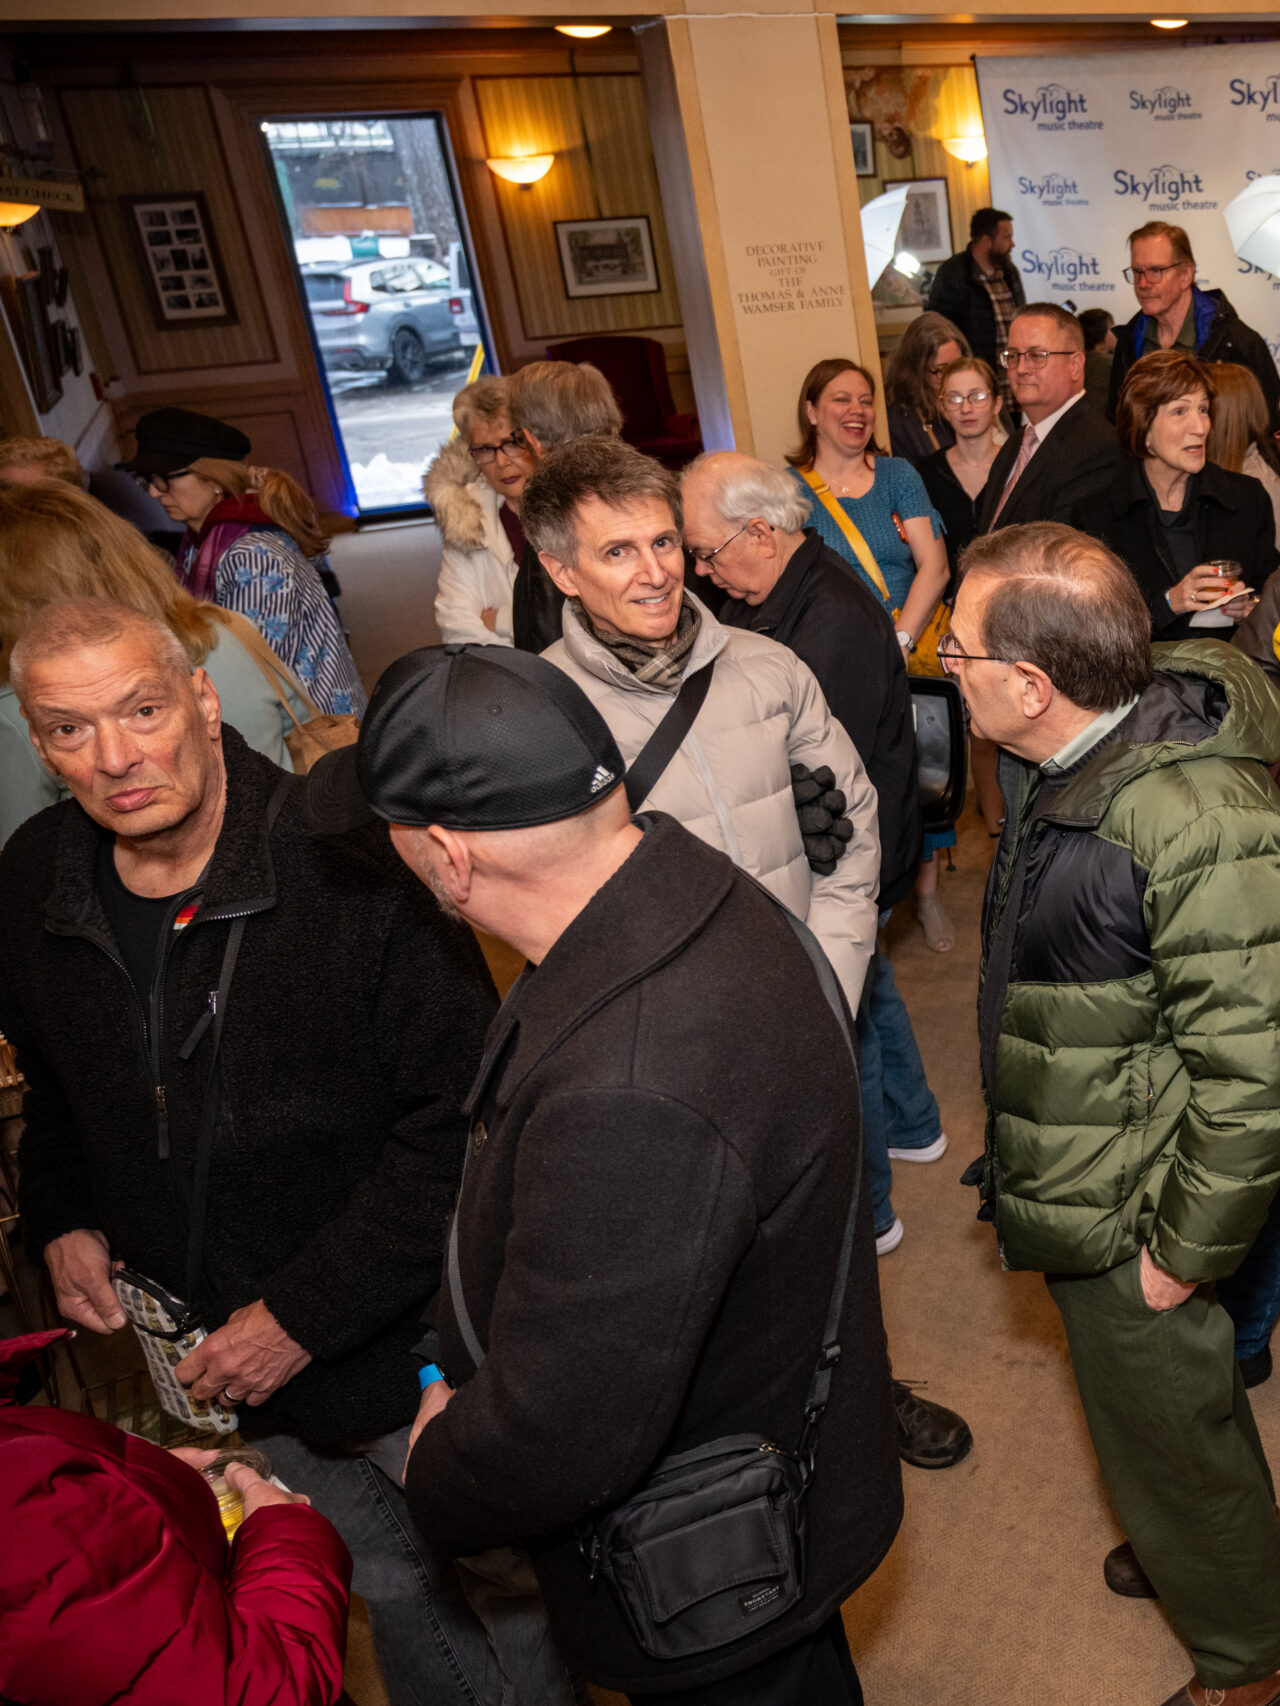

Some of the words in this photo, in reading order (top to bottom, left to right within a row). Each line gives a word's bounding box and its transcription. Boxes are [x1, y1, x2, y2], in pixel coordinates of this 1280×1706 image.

[1003, 88, 1088, 121] Skylight
[1129, 90, 1192, 115] Skylight
[1037, 120, 1066, 131] music
[1068, 118, 1104, 131] theatre
[1154, 113, 1176, 122] music
[1177, 112, 1202, 121] theatre
[1018, 176, 1079, 200] Skylight
[1113, 169, 1204, 202] Skylight
[1149, 202, 1180, 213] music
[1182, 200, 1218, 212] theatre
[746, 241, 824, 257] DECORATIVE
[757, 254, 818, 268] PAINTING
[1021, 249, 1100, 281] Skylight
[769, 267, 791, 277] GIFT
[778, 276, 803, 288] THE
[1052, 282, 1077, 292] music
[1079, 281, 1115, 292] theatre
[737, 290, 792, 304] THOMAS
[796, 289, 805, 299] &
[810, 285, 846, 297] ANNE
[743, 301, 796, 315] WAMSER
[800, 297, 843, 310] FAMILY
[591, 772, 615, 793] adidas
